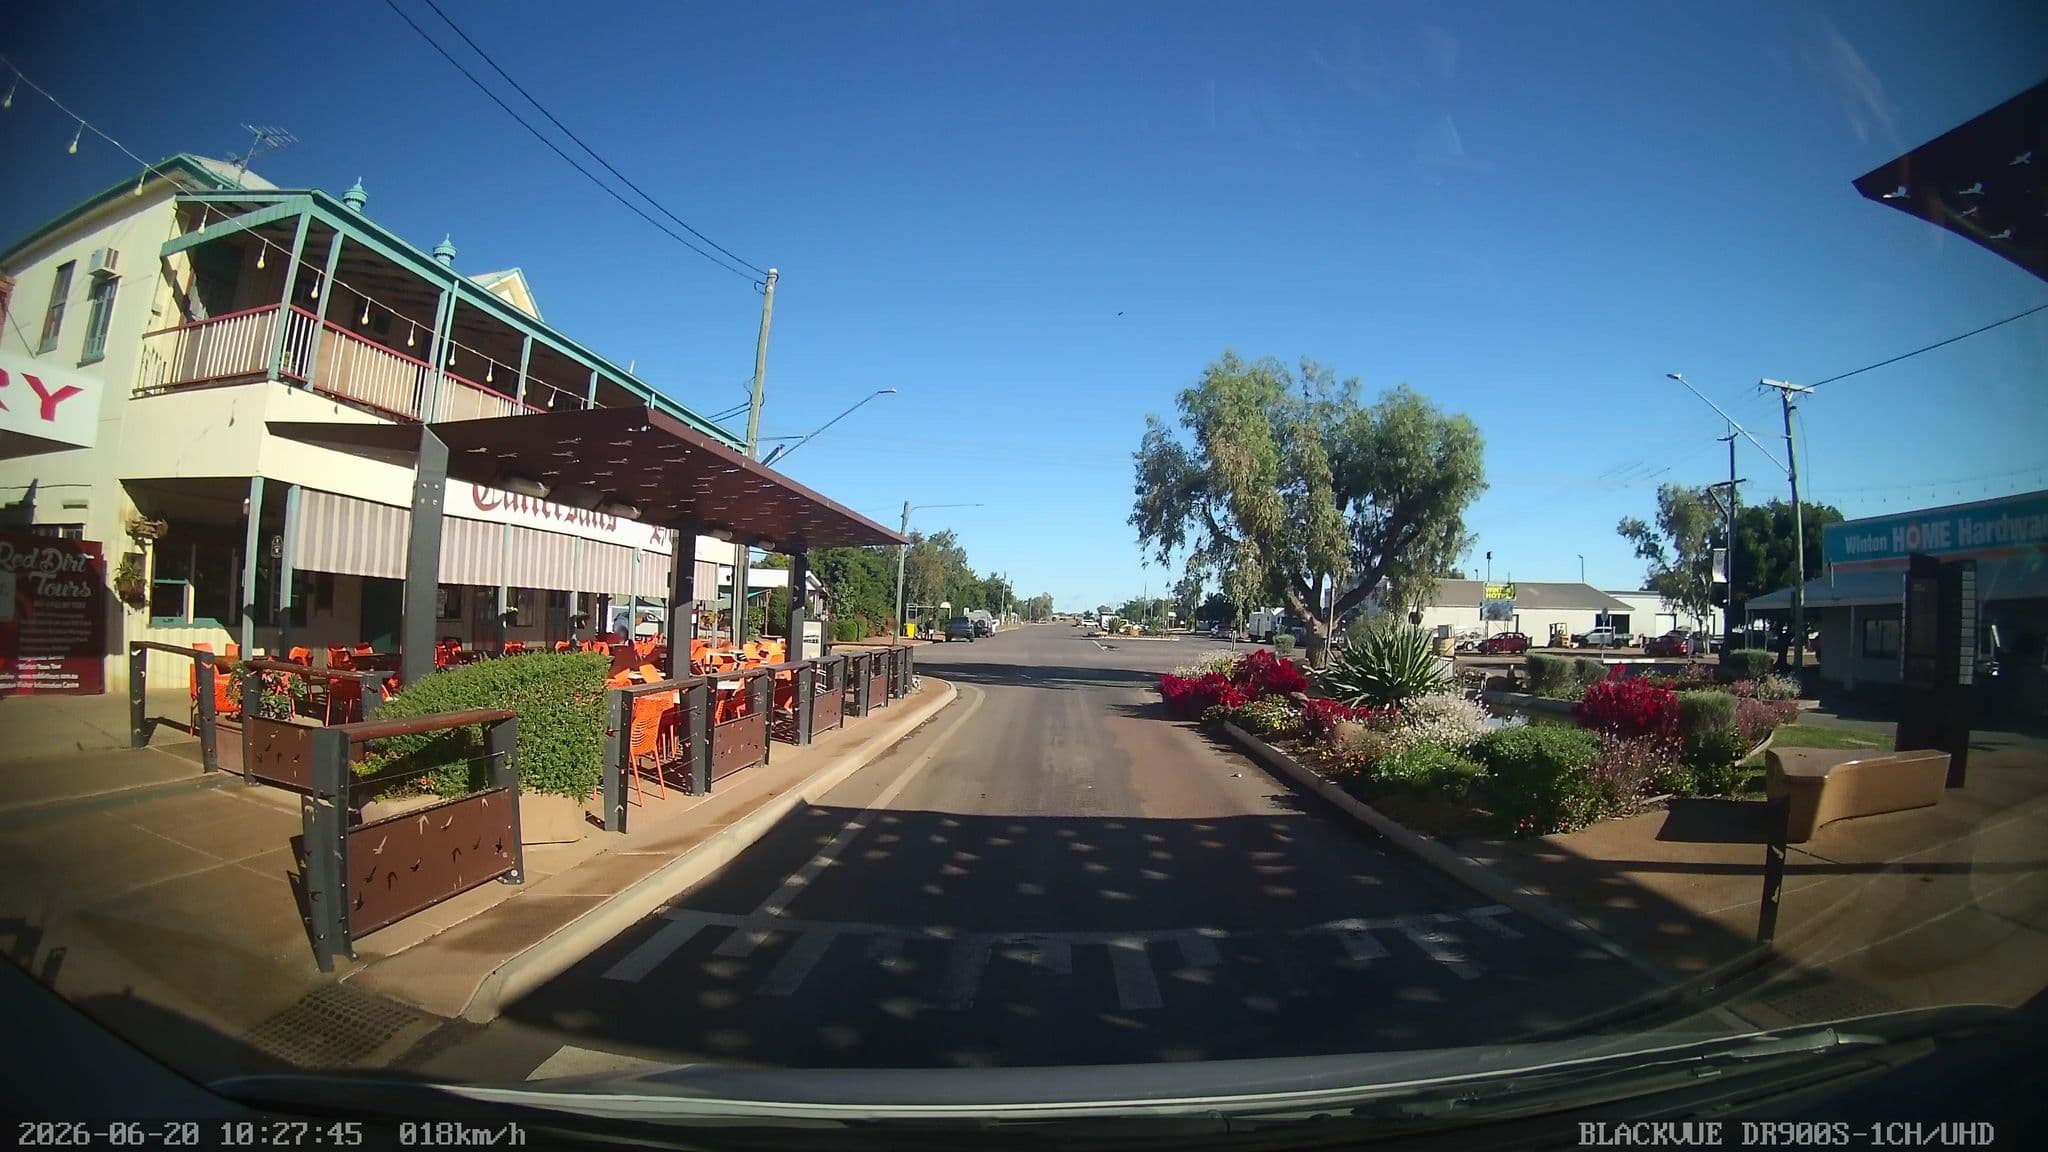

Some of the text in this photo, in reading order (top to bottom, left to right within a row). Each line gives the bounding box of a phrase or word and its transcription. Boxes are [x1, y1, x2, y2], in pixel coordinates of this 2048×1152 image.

[0, 368, 85, 422] Y
[1844, 533, 1887, 554] Winton
[1892, 519, 1953, 553] HOME
[0, 541, 95, 573] Red Dirt
[29, 571, 92, 598] Tours
